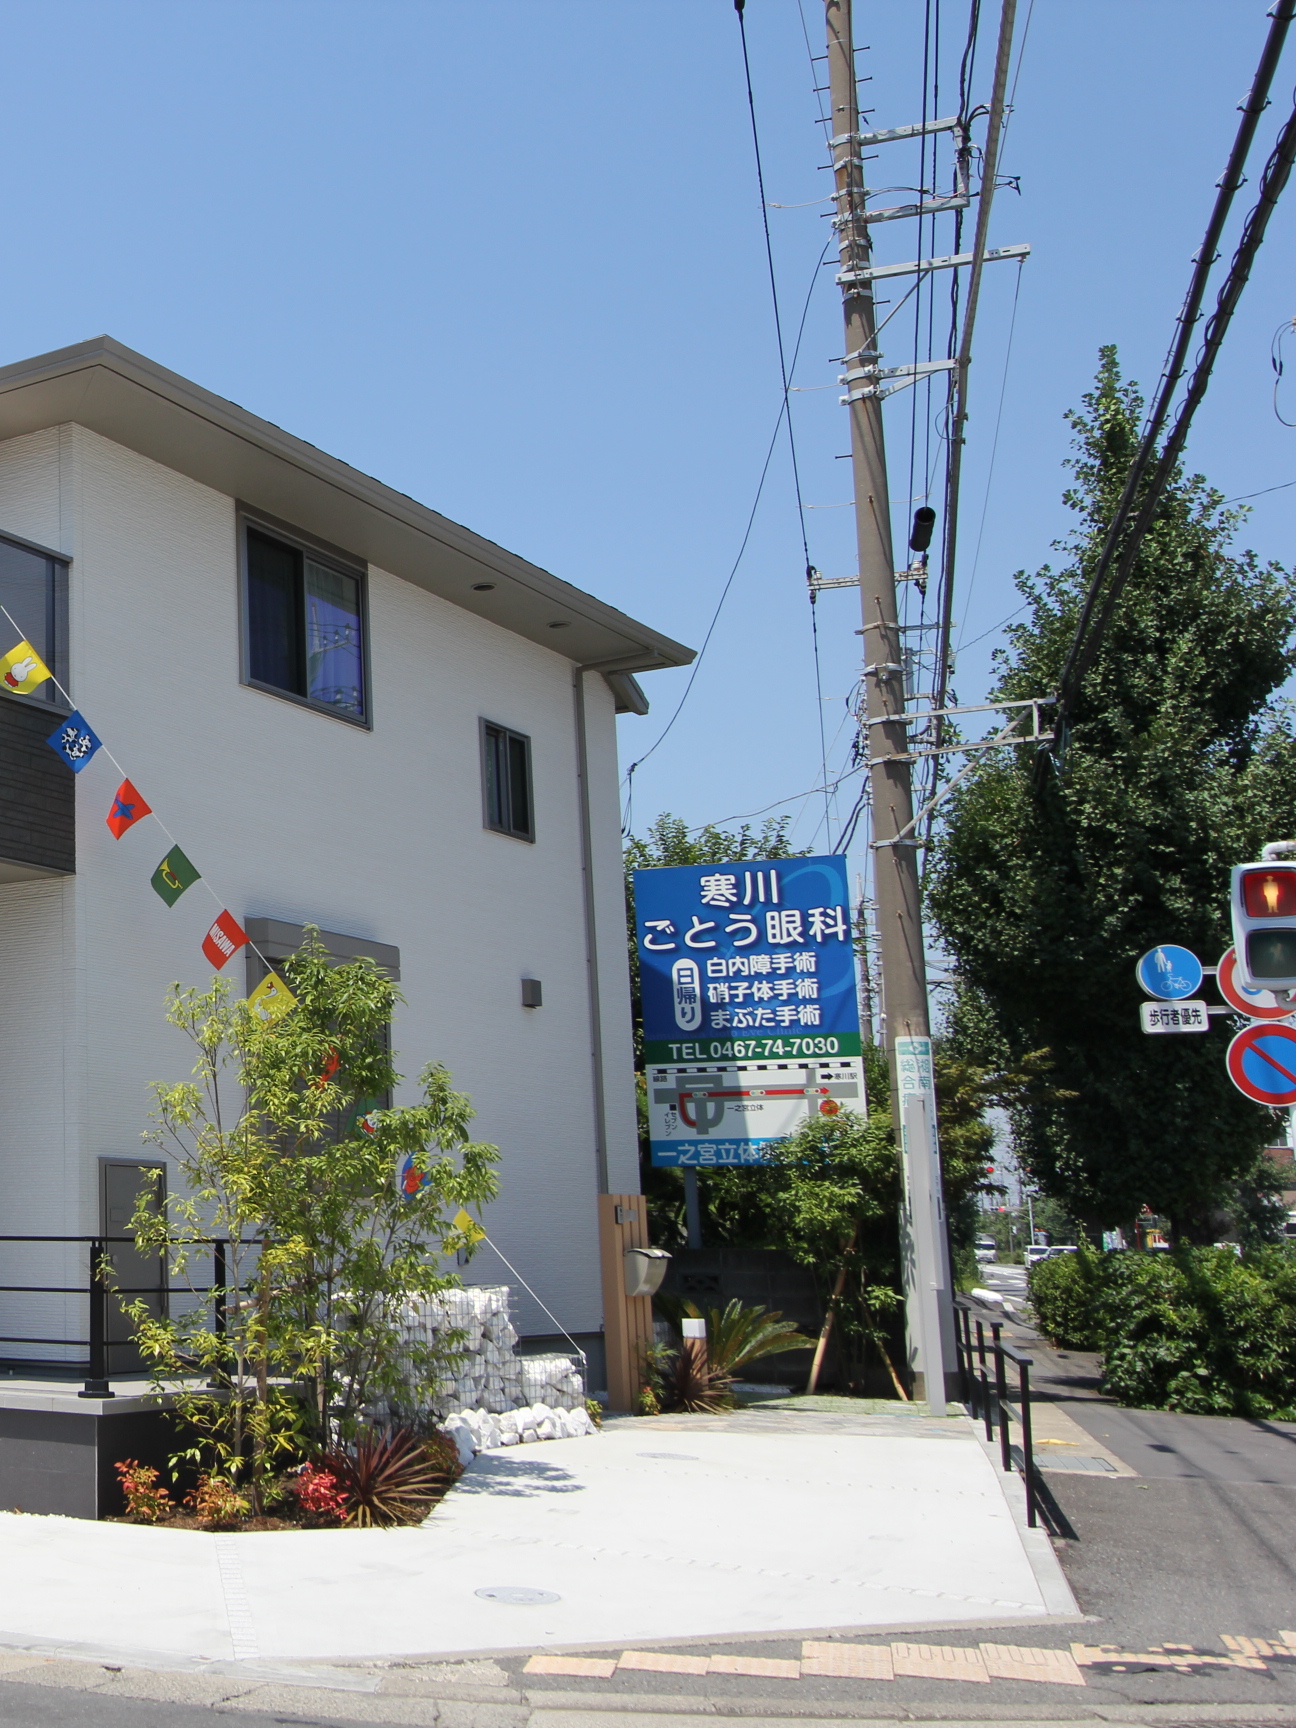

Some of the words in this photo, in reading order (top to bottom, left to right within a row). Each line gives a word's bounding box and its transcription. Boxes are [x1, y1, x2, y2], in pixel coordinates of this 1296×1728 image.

[700, 869, 778, 907] 寒川
[209, 923, 236, 957] MISAWA
[643, 905, 847, 951] ごとう眼科
[706, 952, 816, 978] 白内障手術
[676, 967, 697, 1024] 日帰り
[707, 978, 819, 1003] 硝子体手術
[710, 1004, 821, 1029] まぶた手術
[1149, 1007, 1203, 1026] 歩行者優先
[742, 1027, 764, 1038] Eye
[768, 1025, 803, 1036] Clinic
[668, 1042, 708, 1060] TEL
[710, 1037, 839, 1058] 0467-74-7030
[727, 1104, 764, 1112] 一之宮立体
[664, 1111, 672, 1137] イレブン
